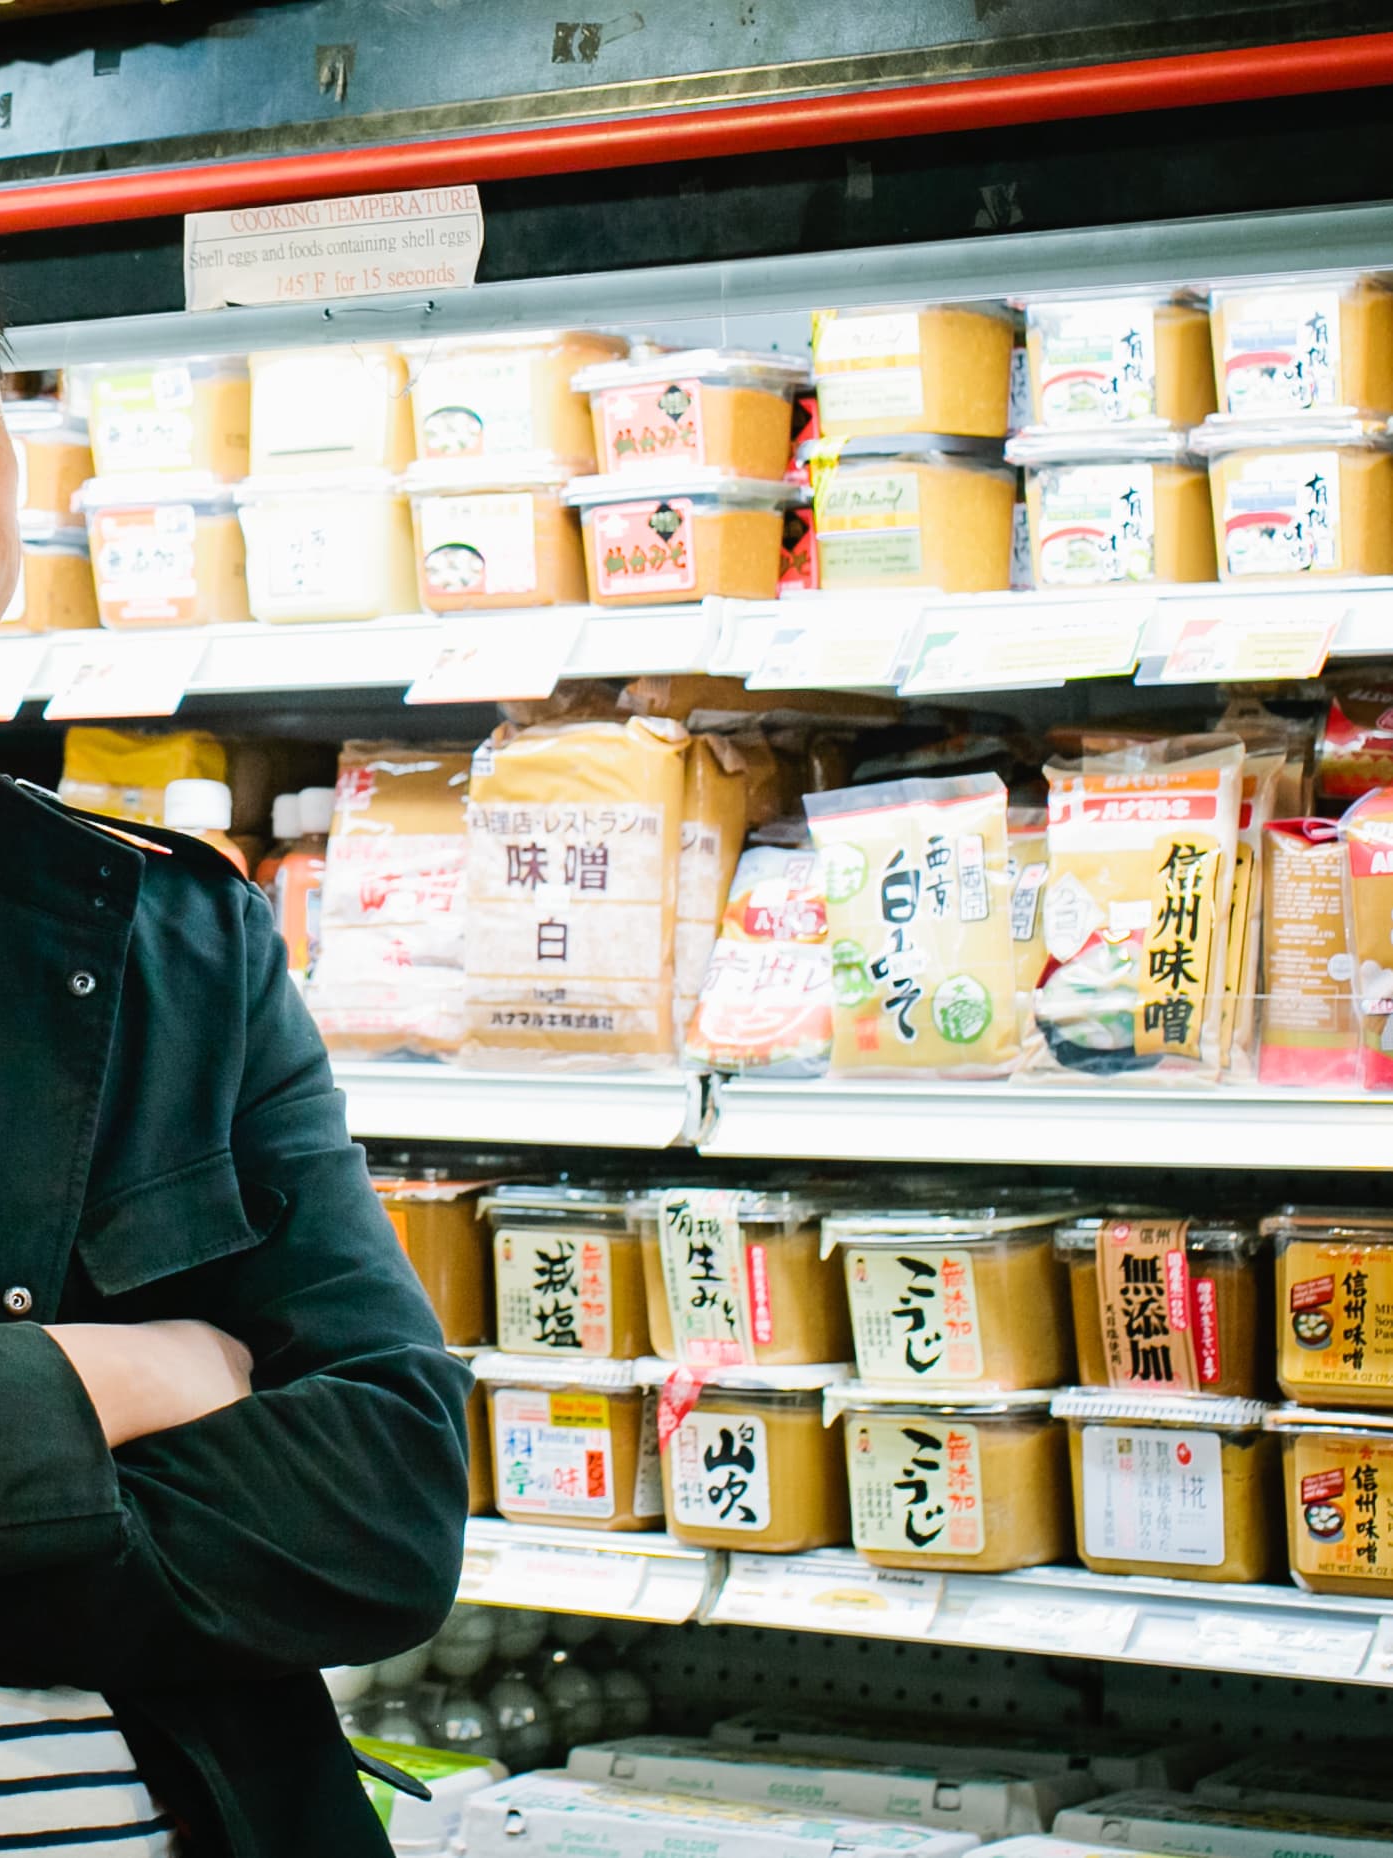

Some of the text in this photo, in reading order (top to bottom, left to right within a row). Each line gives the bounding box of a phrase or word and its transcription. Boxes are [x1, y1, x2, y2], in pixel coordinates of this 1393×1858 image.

[190, 228, 472, 270] Shell eggs and foods containing shell eggs
[230, 187, 478, 233] COOKING TEMPERATURE
[335, 270, 356, 293] for
[362, 266, 382, 290] 15
[388, 261, 455, 287] seconds
[604, 541, 687, 575] 仙台みそ
[506, 840, 610, 891] 味噌
[925, 834, 953, 917] 西京
[537, 916, 568, 962] 白
[1144, 842, 1209, 1045] 信州味噌
[491, 1011, 615, 1031] ハナマルキ株式会社
[1140, 1227, 1172, 1244] 信州
[533, 1240, 583, 1348] 減塩
[688, 1243, 737, 1342] 生みそ
[891, 1256, 943, 1374] こうじ
[940, 1258, 973, 1339] 無添加
[1119, 1253, 1174, 1382] 無添加
[1341, 1269, 1368, 1370] 信州味噌
[704, 1428, 758, 1524] 山吹
[893, 1427, 945, 1548] こうじ
[946, 1431, 976, 1513] 無添加
[1351, 1463, 1380, 1564] 信州味噌
[767, 1782, 825, 1799] GOLDEN
[663, 1837, 720, 1853] GOLDEN
